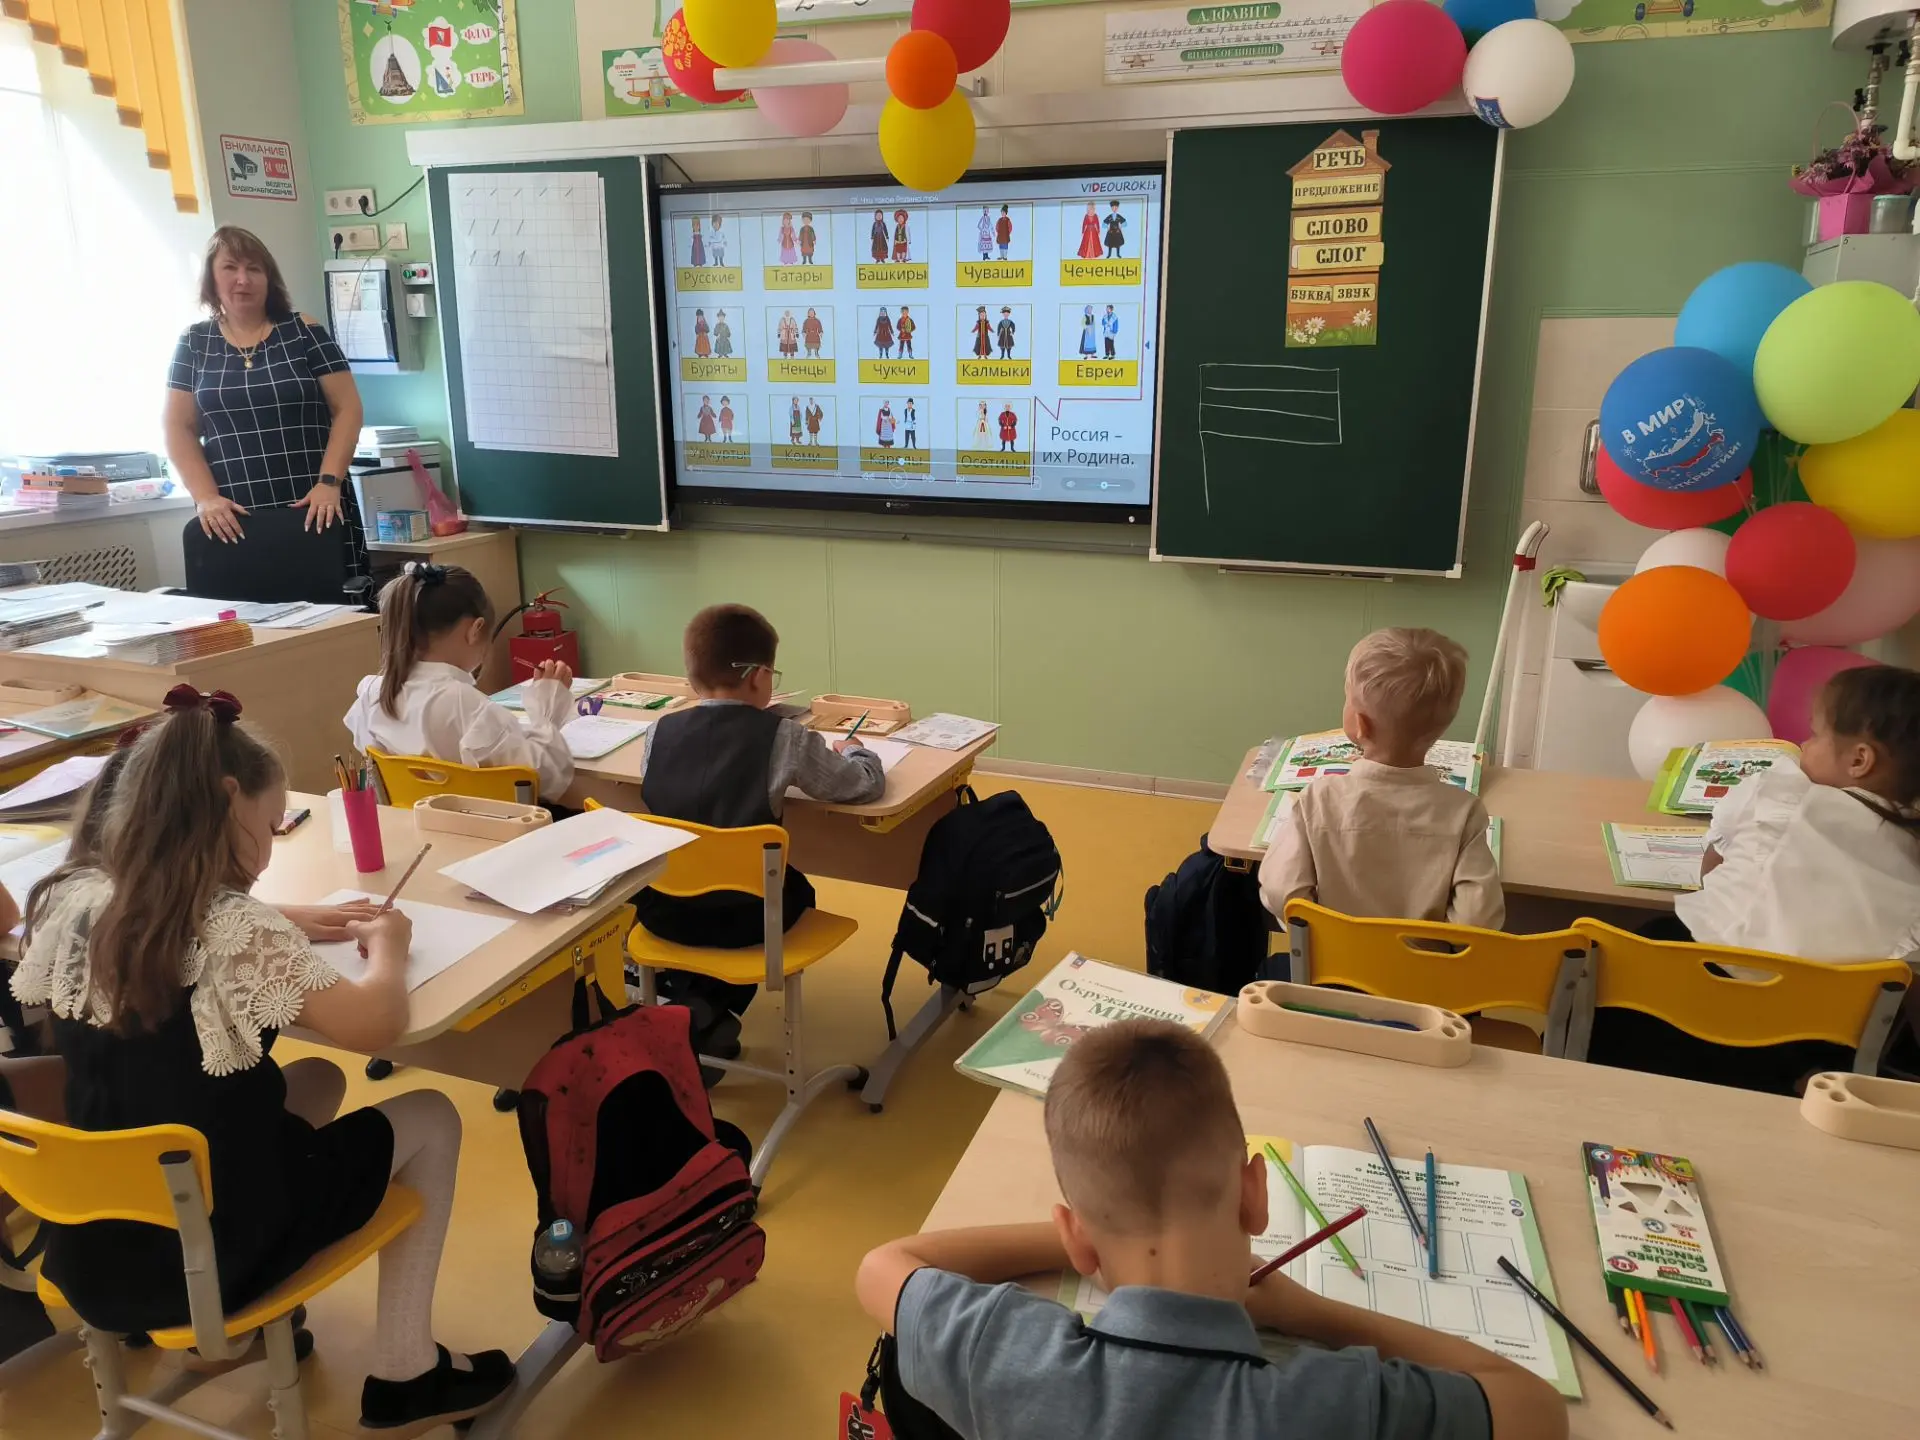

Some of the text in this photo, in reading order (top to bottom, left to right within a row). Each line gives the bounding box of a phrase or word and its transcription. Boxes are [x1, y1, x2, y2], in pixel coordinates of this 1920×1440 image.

[1196, 5, 1272, 22] АЛФАВИТ
[464, 27, 493, 40] ФЛАГ
[469, 71, 495, 83] ГЕРБ
[224, 141, 288, 156] ВНИМАНИЕ!
[1315, 149, 1365, 169] РЕЧЬ
[1294, 182, 1379, 197] ПРЕДЛОЖЕНИЕ
[1306, 217, 1369, 236] СЛОВО
[1315, 247, 1367, 264] СЛОГ
[683, 270, 736, 285] Русские
[773, 269, 823, 284] Татары
[858, 267, 928, 284] Башкиры
[964, 265, 1025, 283] Чуваши
[1064, 263, 1139, 280] Чеченцы
[1290, 289, 1331, 302] БУКВА
[1337, 287, 1371, 299] ЗВУК
[691, 361, 738, 377] Буряты
[780, 363, 827, 377] Ненцы
[873, 363, 917, 378] Чукчи
[962, 364, 1030, 379] Калмыки
[1076, 364, 1124, 379] Евреи
[1051, 425, 1109, 442] Россия
[1042, 449, 1135, 467] их Родина.
[1058, 978, 1185, 1023] Окружающий
[1627, 1251, 1708, 1273] COLOURED
[1641, 1244, 1706, 1264] PENCILS
